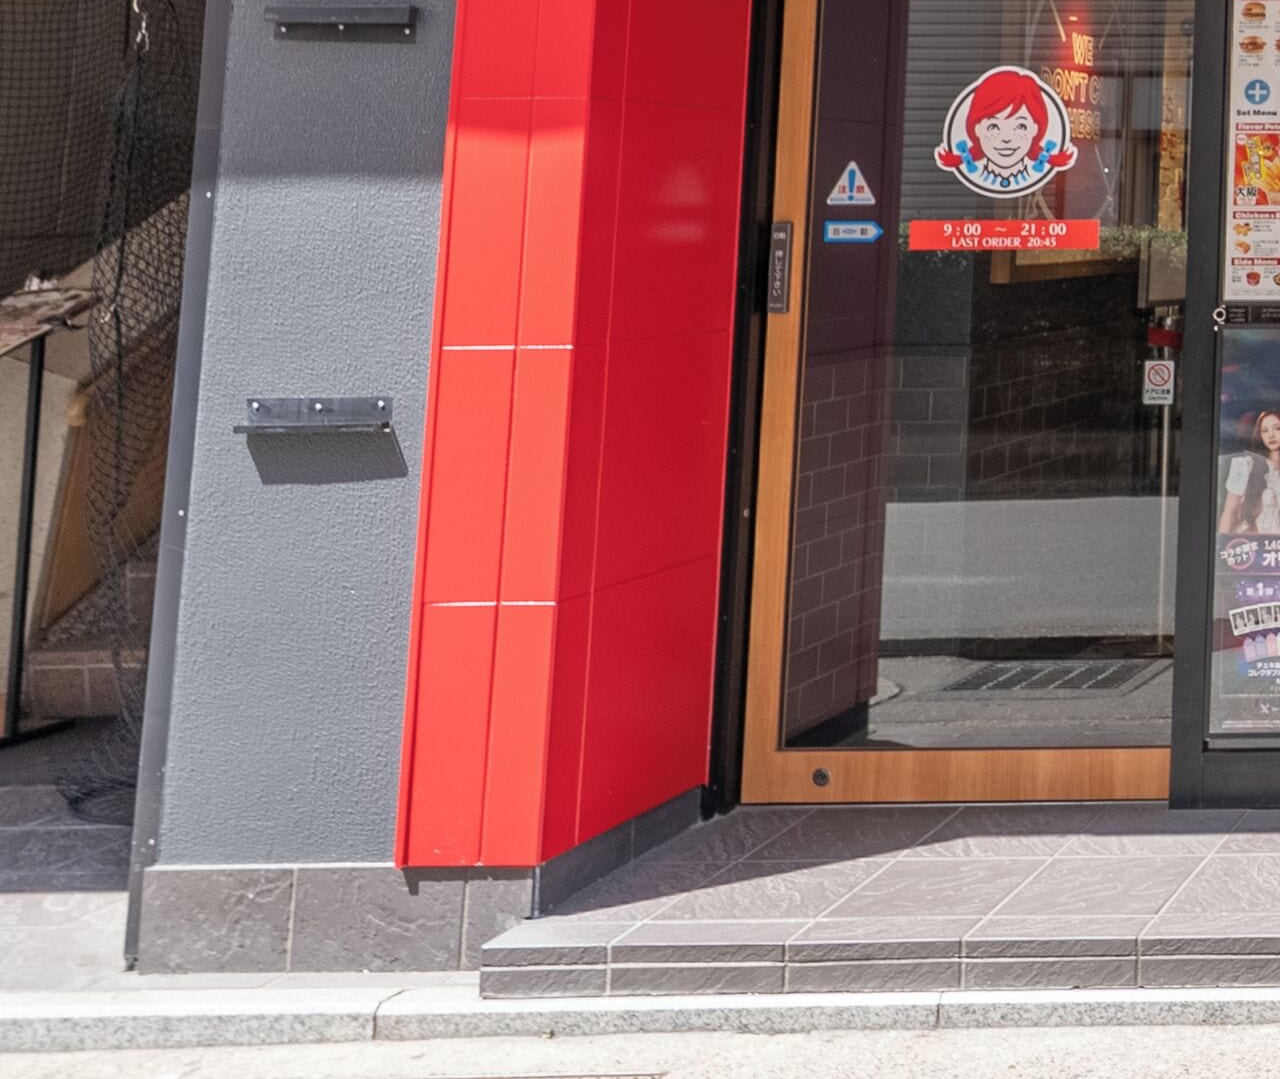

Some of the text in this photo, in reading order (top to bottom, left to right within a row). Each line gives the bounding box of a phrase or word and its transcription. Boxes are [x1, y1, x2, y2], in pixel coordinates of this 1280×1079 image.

[1071, 32, 1094, 66] WE
[1236, 109, 1251, 117] Set
[1252, 109, 1278, 117] Menu
[1020, 223, 1067, 236] 21:00
[951, 237, 1057, 248] LAST ORDER 20:45
[1234, 258, 1278, 266] Side Menu
